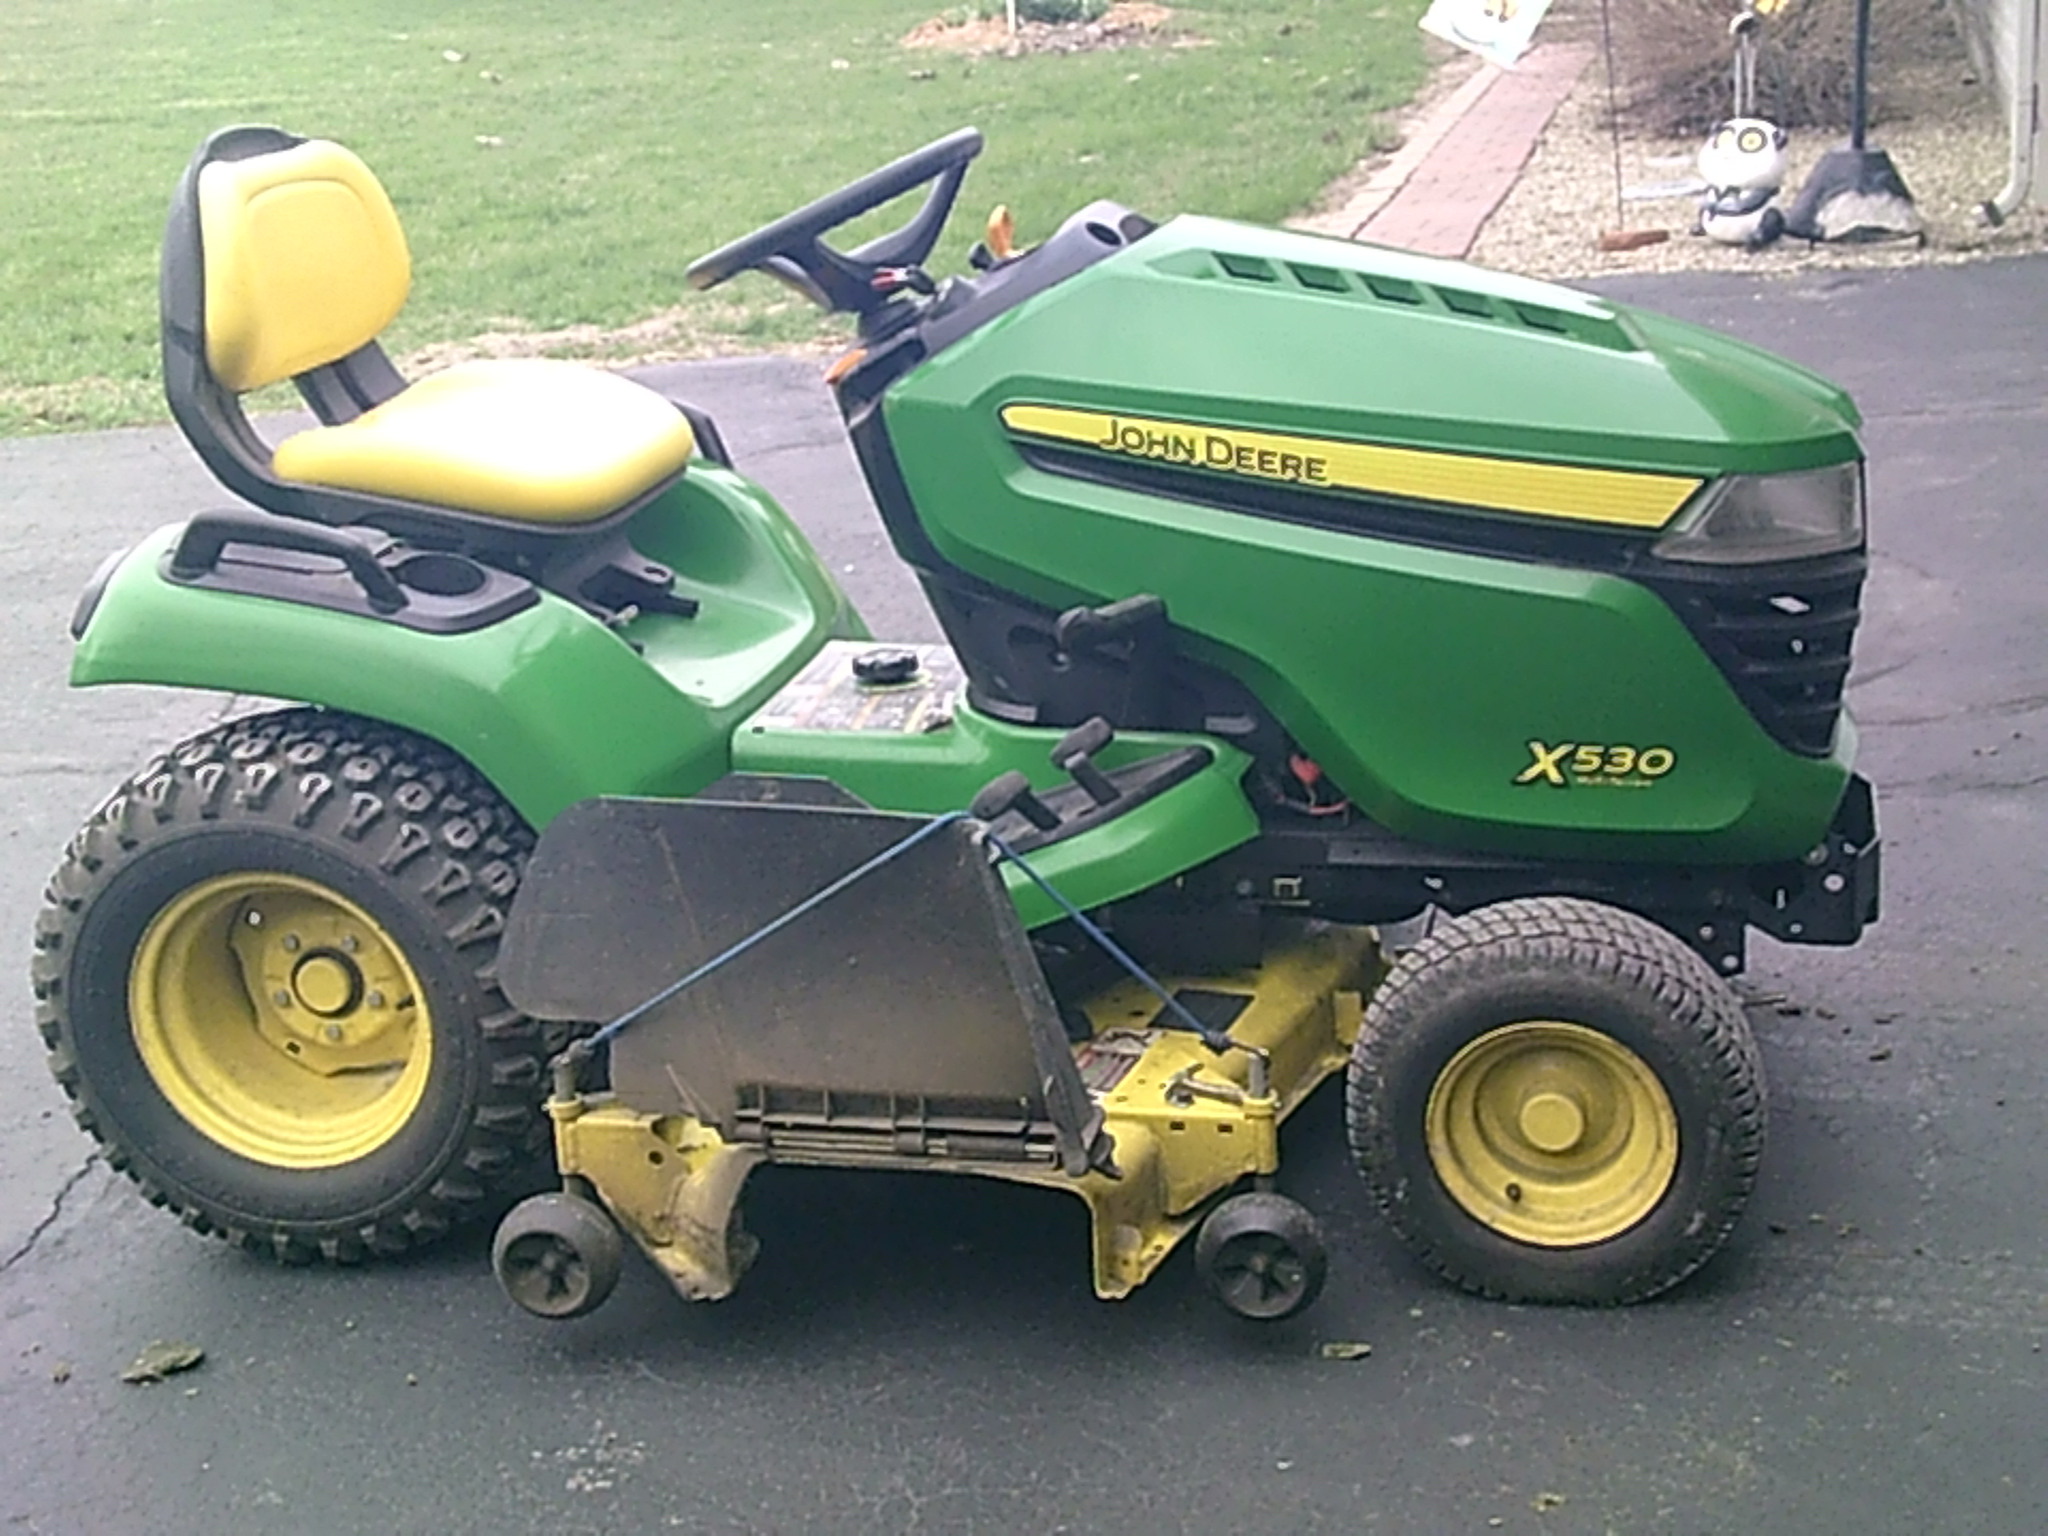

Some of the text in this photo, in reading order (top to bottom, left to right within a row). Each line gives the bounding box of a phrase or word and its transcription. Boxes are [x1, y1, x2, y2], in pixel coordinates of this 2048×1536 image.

[1100, 418, 1328, 482] JOHN DEERE
[1514, 740, 1676, 785] X530
